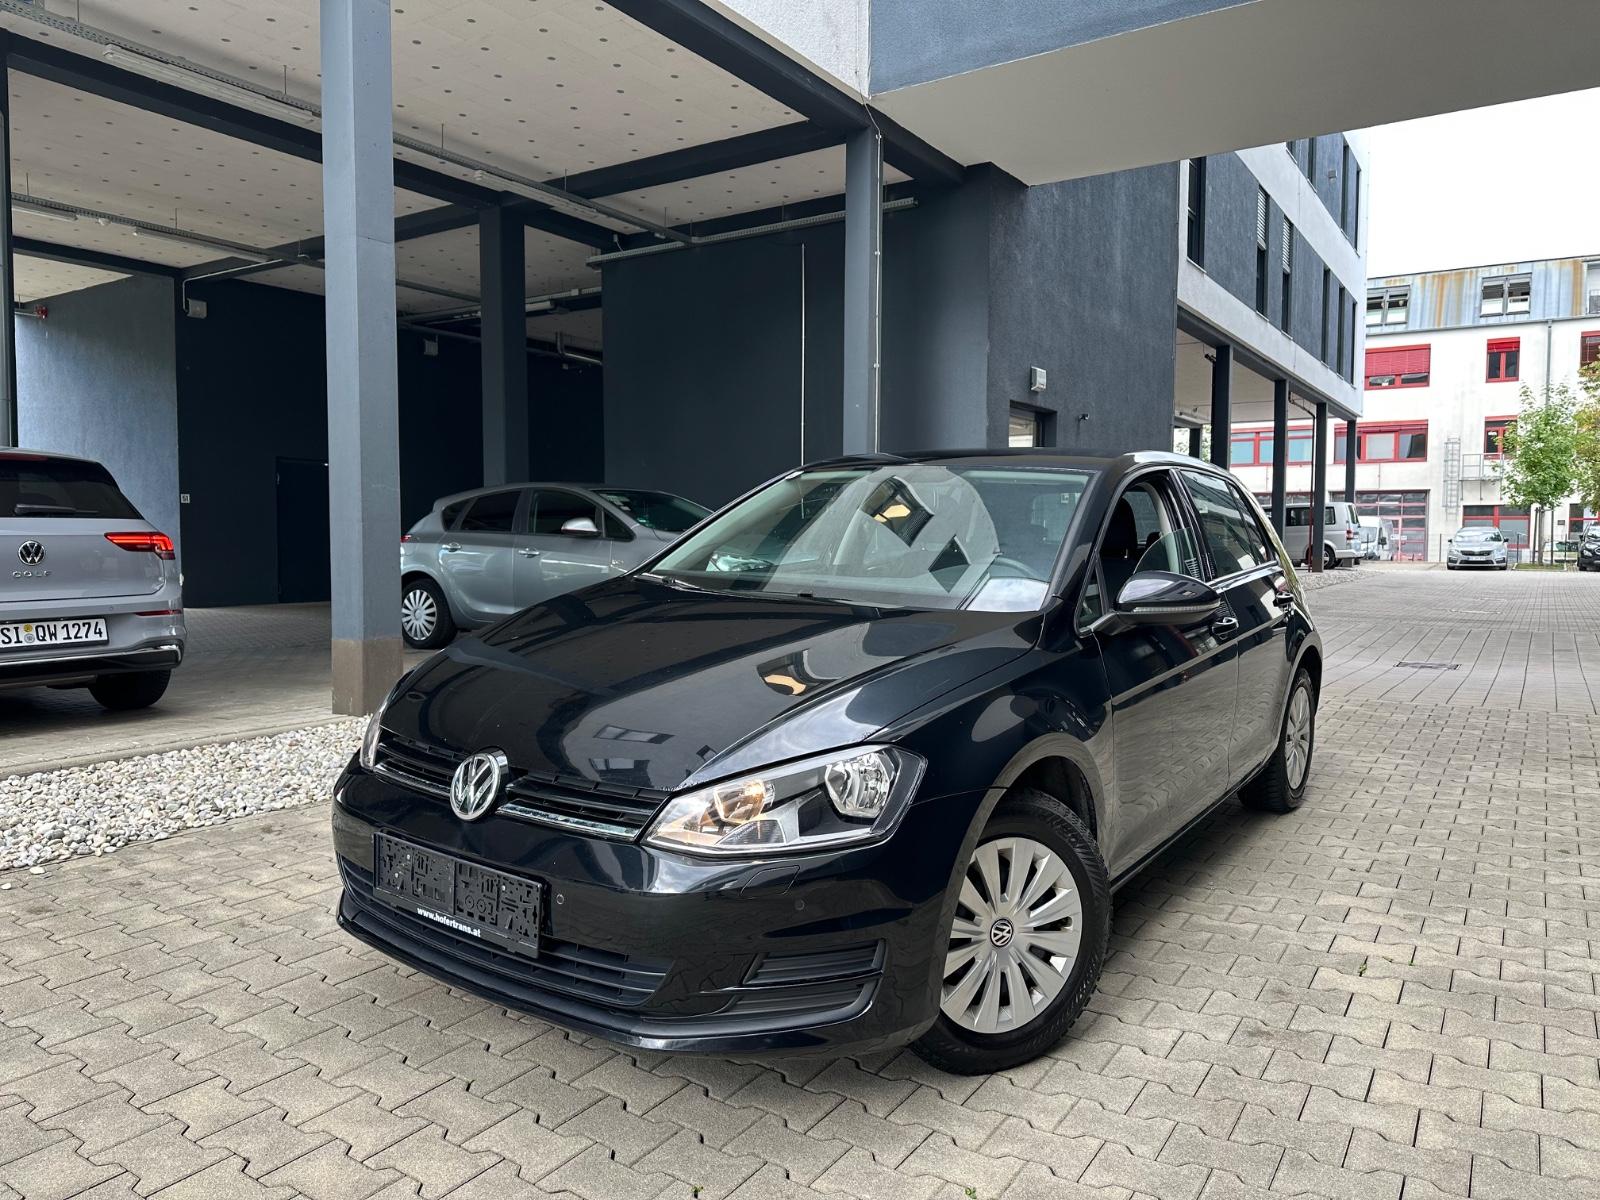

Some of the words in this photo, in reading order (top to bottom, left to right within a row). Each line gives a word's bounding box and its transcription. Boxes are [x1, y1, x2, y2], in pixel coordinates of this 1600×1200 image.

[0, 626, 23, 645] SI
[35, 623, 57, 642] QW
[61, 621, 103, 640] 1274
[417, 907, 481, 938] www.hofertrans.at
